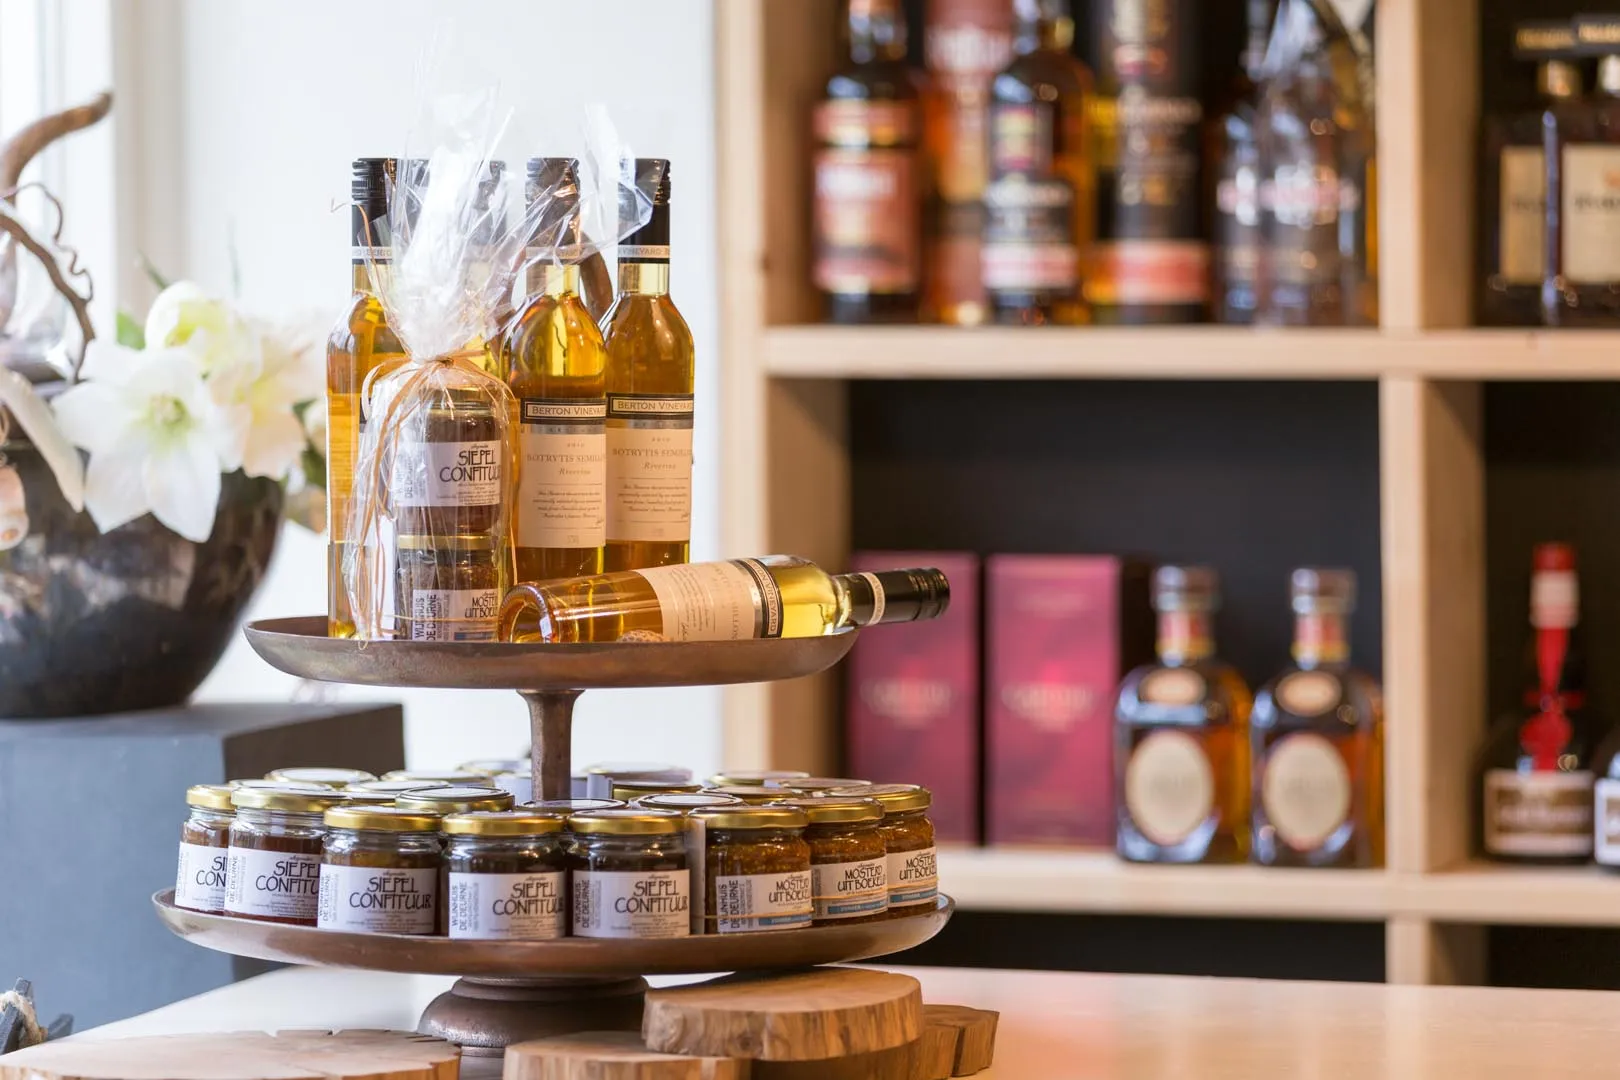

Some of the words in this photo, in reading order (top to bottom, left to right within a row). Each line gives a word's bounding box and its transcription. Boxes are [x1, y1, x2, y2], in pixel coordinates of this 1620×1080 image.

[532, 406, 571, 415] BERTON
[618, 401, 656, 410] BERTON
[457, 449, 496, 466] SIEPEL
[464, 607, 479, 618] UIT
[765, 583, 778, 632] VINEYARD
[899, 868, 914, 881] UIT
[367, 876, 419, 893] SIEPEL
[510, 881, 557, 898] SIEPEL
[633, 879, 680, 897] SIEPEL
[837, 880, 854, 892] UIT
[349, 892, 432, 910] CONFITUUR
[718, 884, 729, 926] WJNHUIS
[729, 880, 740, 915] DEURNE
[768, 891, 783, 904] UIT
